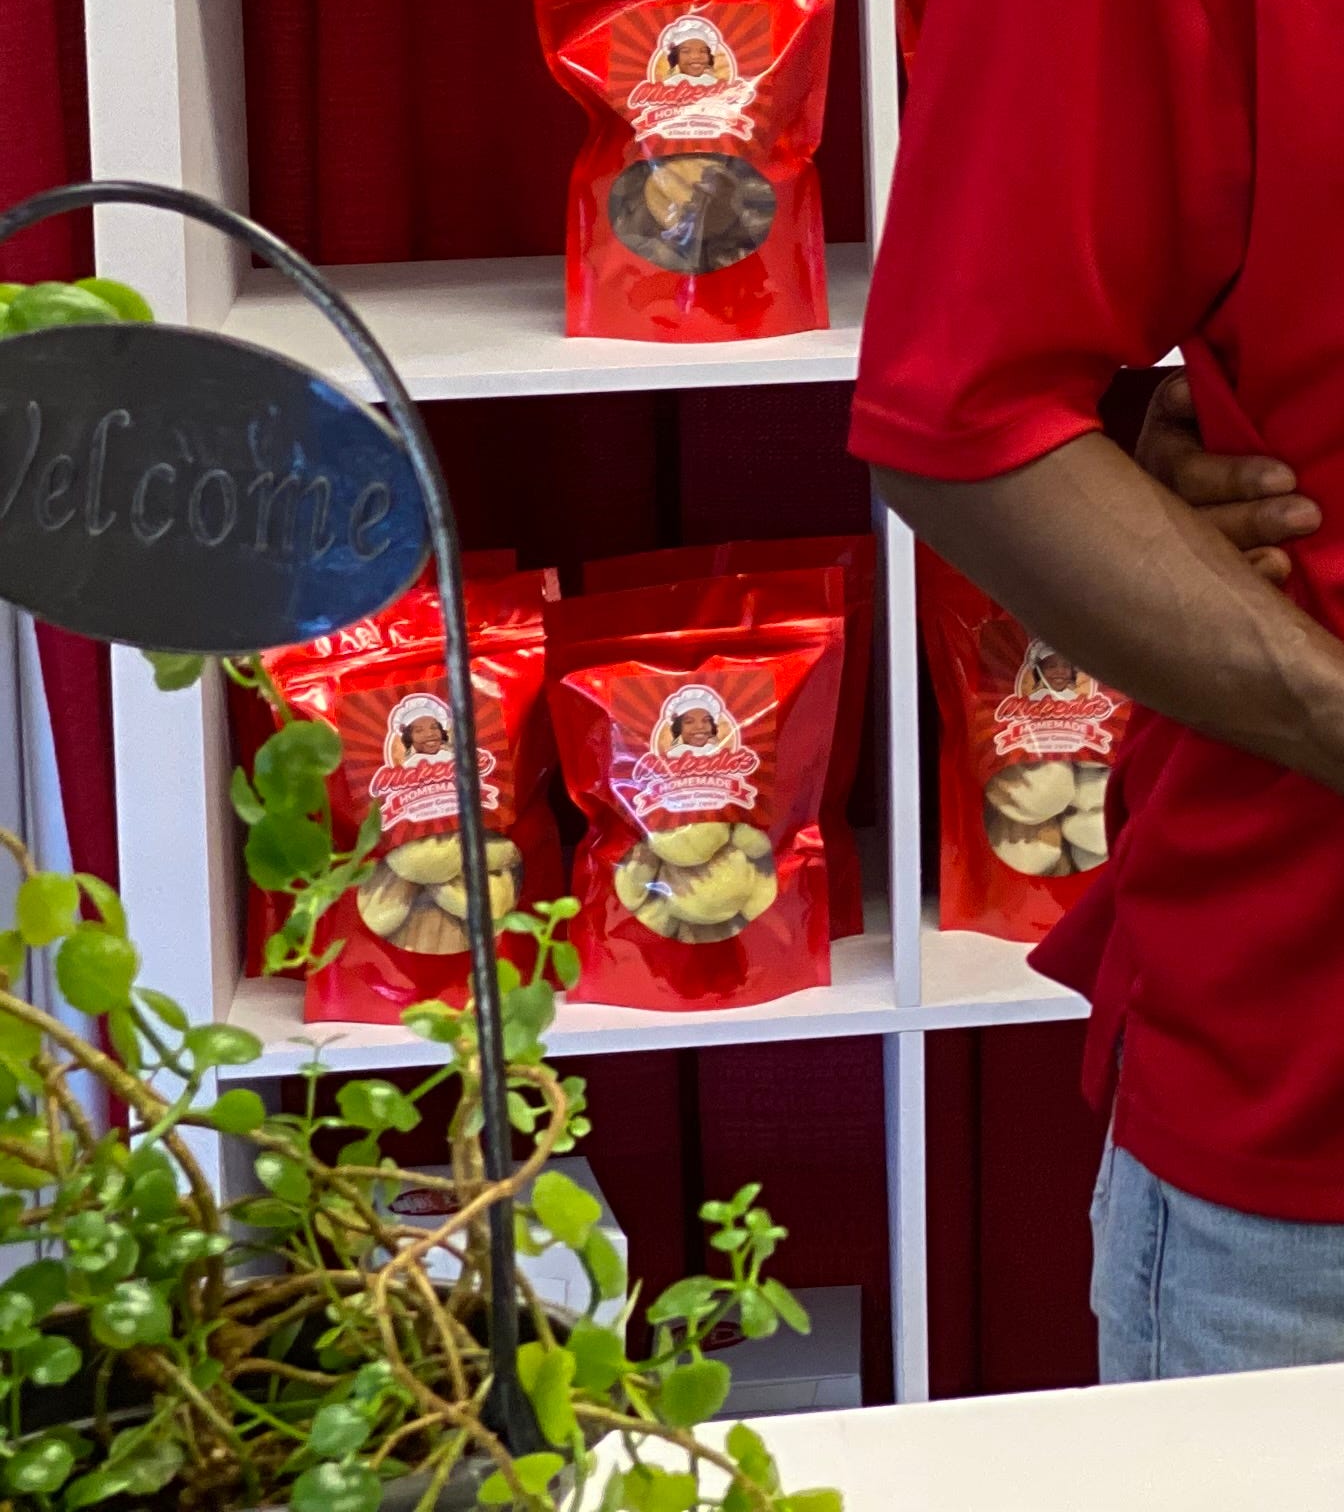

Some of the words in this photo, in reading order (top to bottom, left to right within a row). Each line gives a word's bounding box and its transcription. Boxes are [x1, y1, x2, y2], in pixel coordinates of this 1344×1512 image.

[629, 79, 752, 107] Maked
[997, 693, 1111, 721] Makeda's
[1021, 720, 1088, 735] HOMEMADE
[373, 753, 493, 797] Makes
[634, 748, 757, 782] Makeda's
[399, 780, 457, 805] HOMEMA
